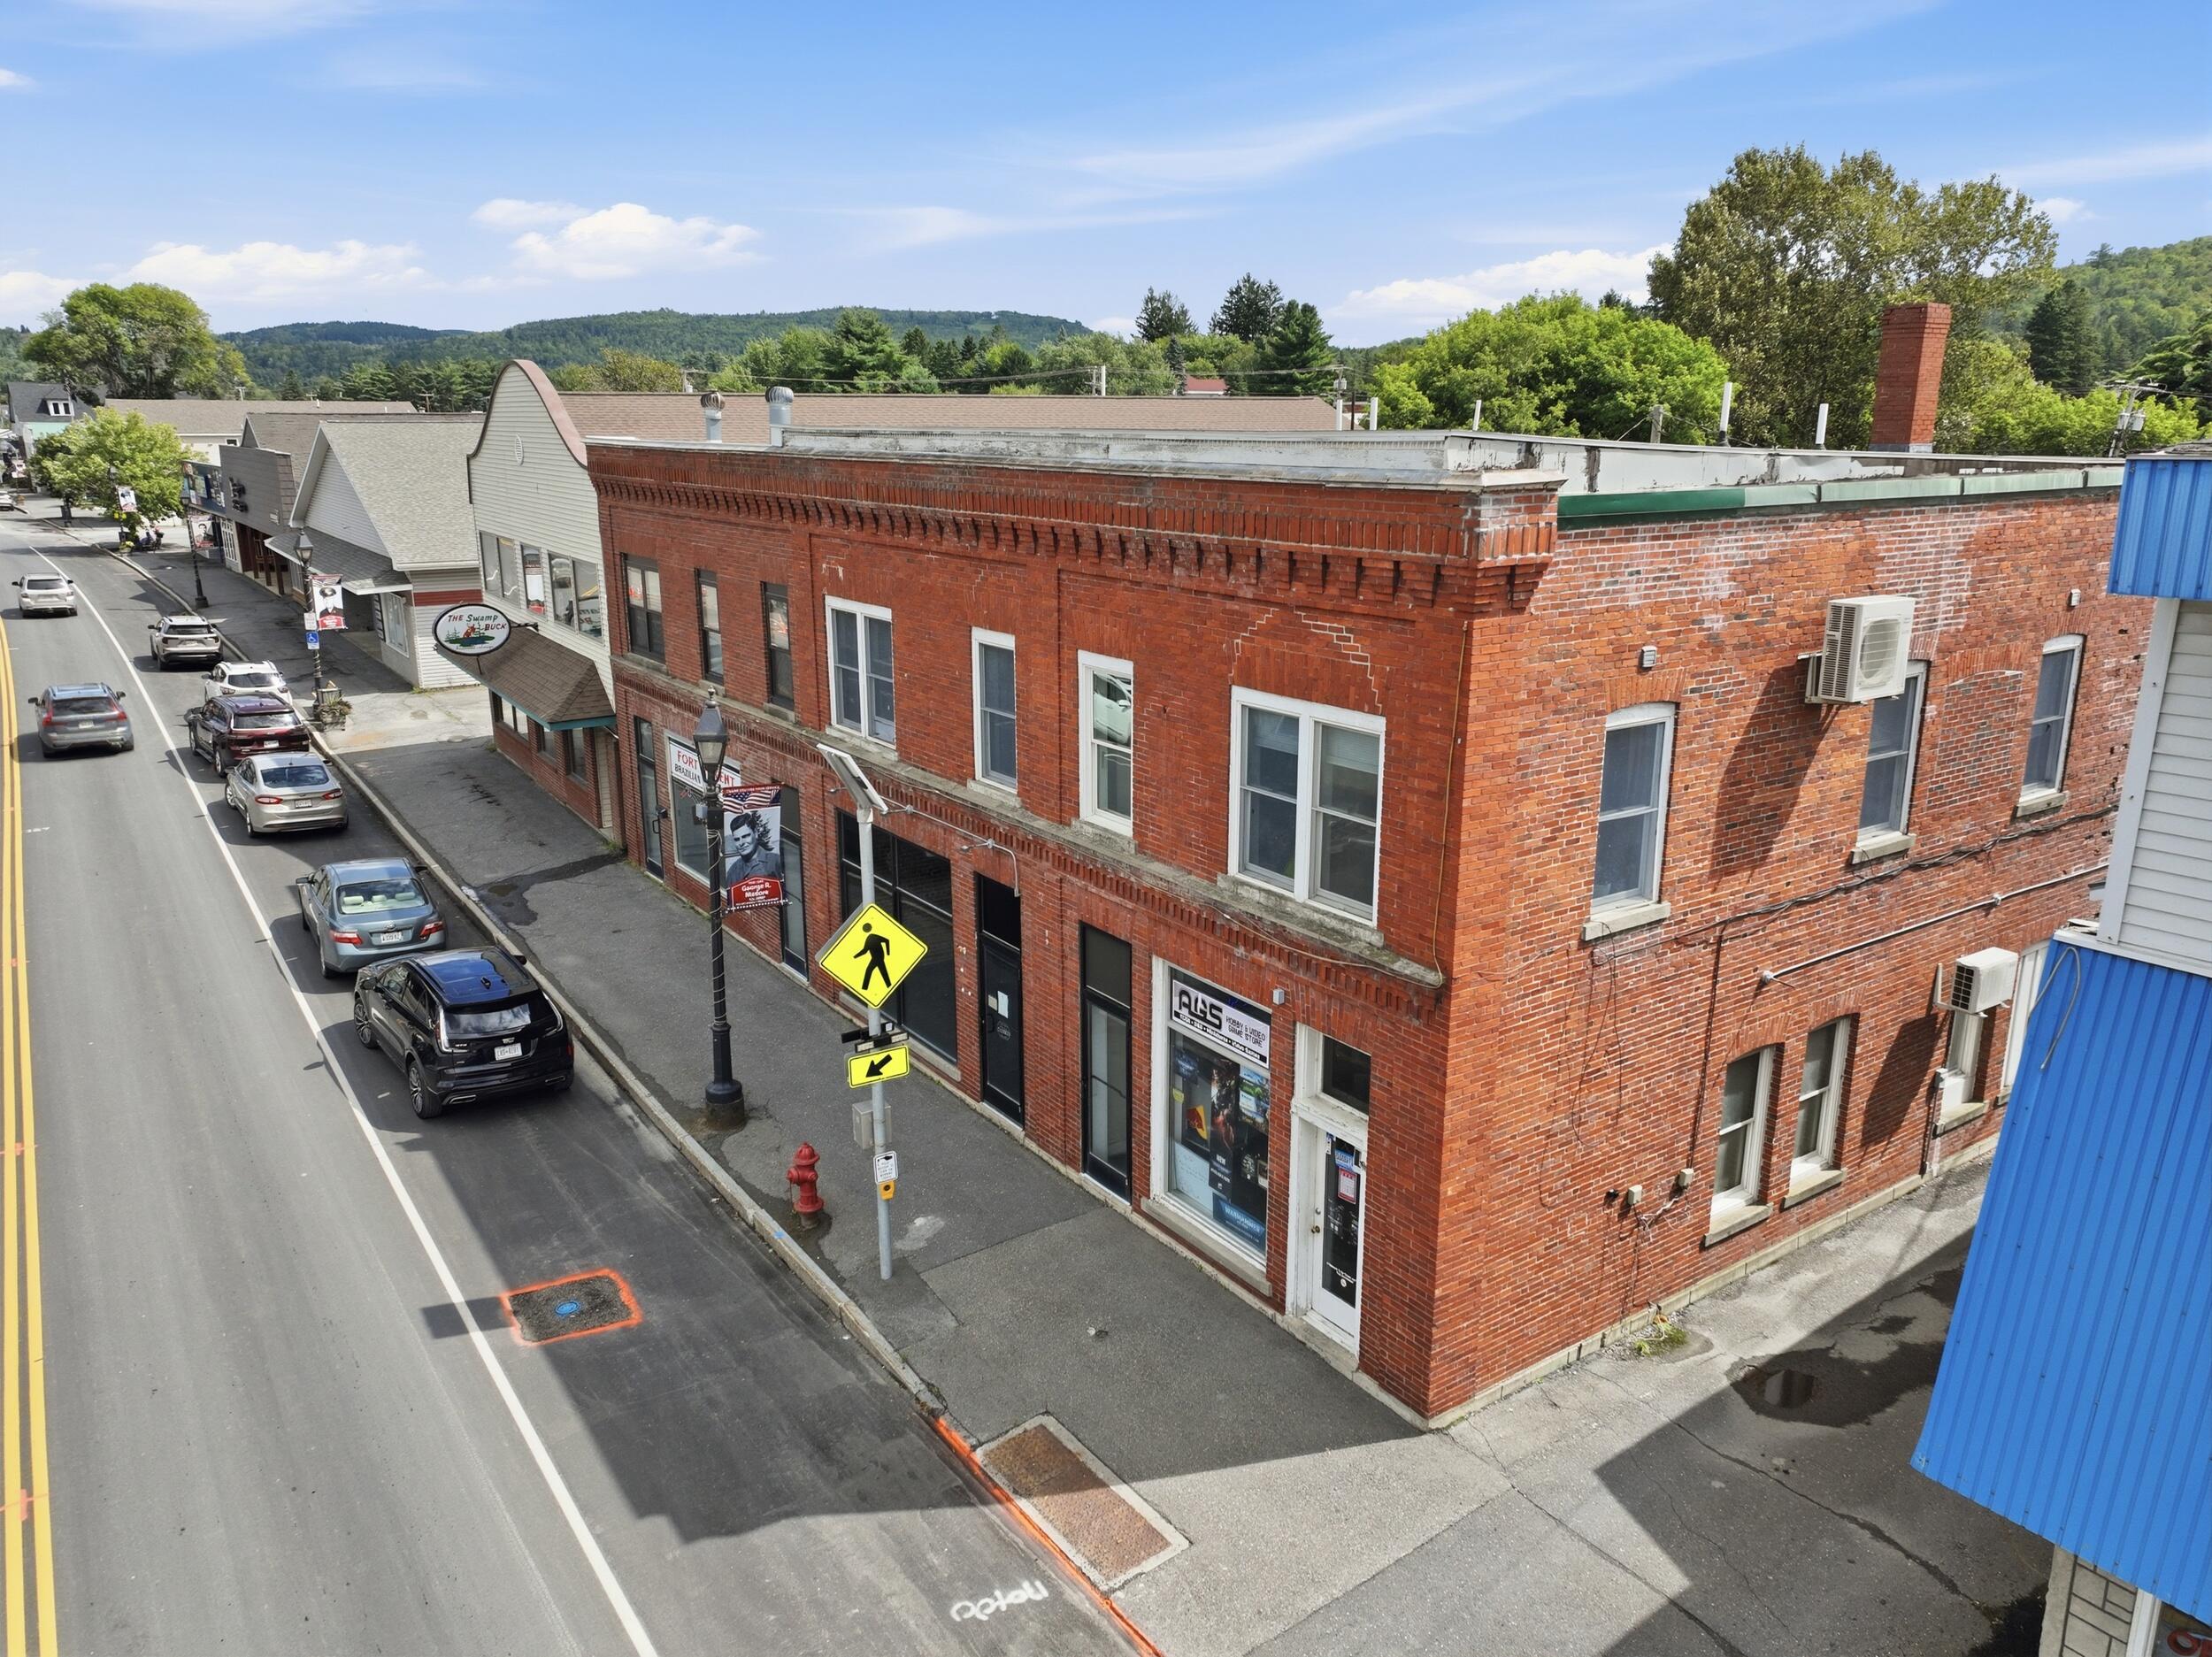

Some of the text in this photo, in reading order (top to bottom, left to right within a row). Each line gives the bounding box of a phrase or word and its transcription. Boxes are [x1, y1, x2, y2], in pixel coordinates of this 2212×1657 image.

[448, 613, 498, 623] THE Swamp
[484, 622, 507, 632] BUCK
[677, 750, 698, 770] FORT
[674, 763, 701, 784] BRAZILIAN
[1225, 1015, 1244, 1030] HOBBY
[1248, 1026, 1266, 1041] VIDEO
[1228, 1024, 1263, 1048] GAME STORE
